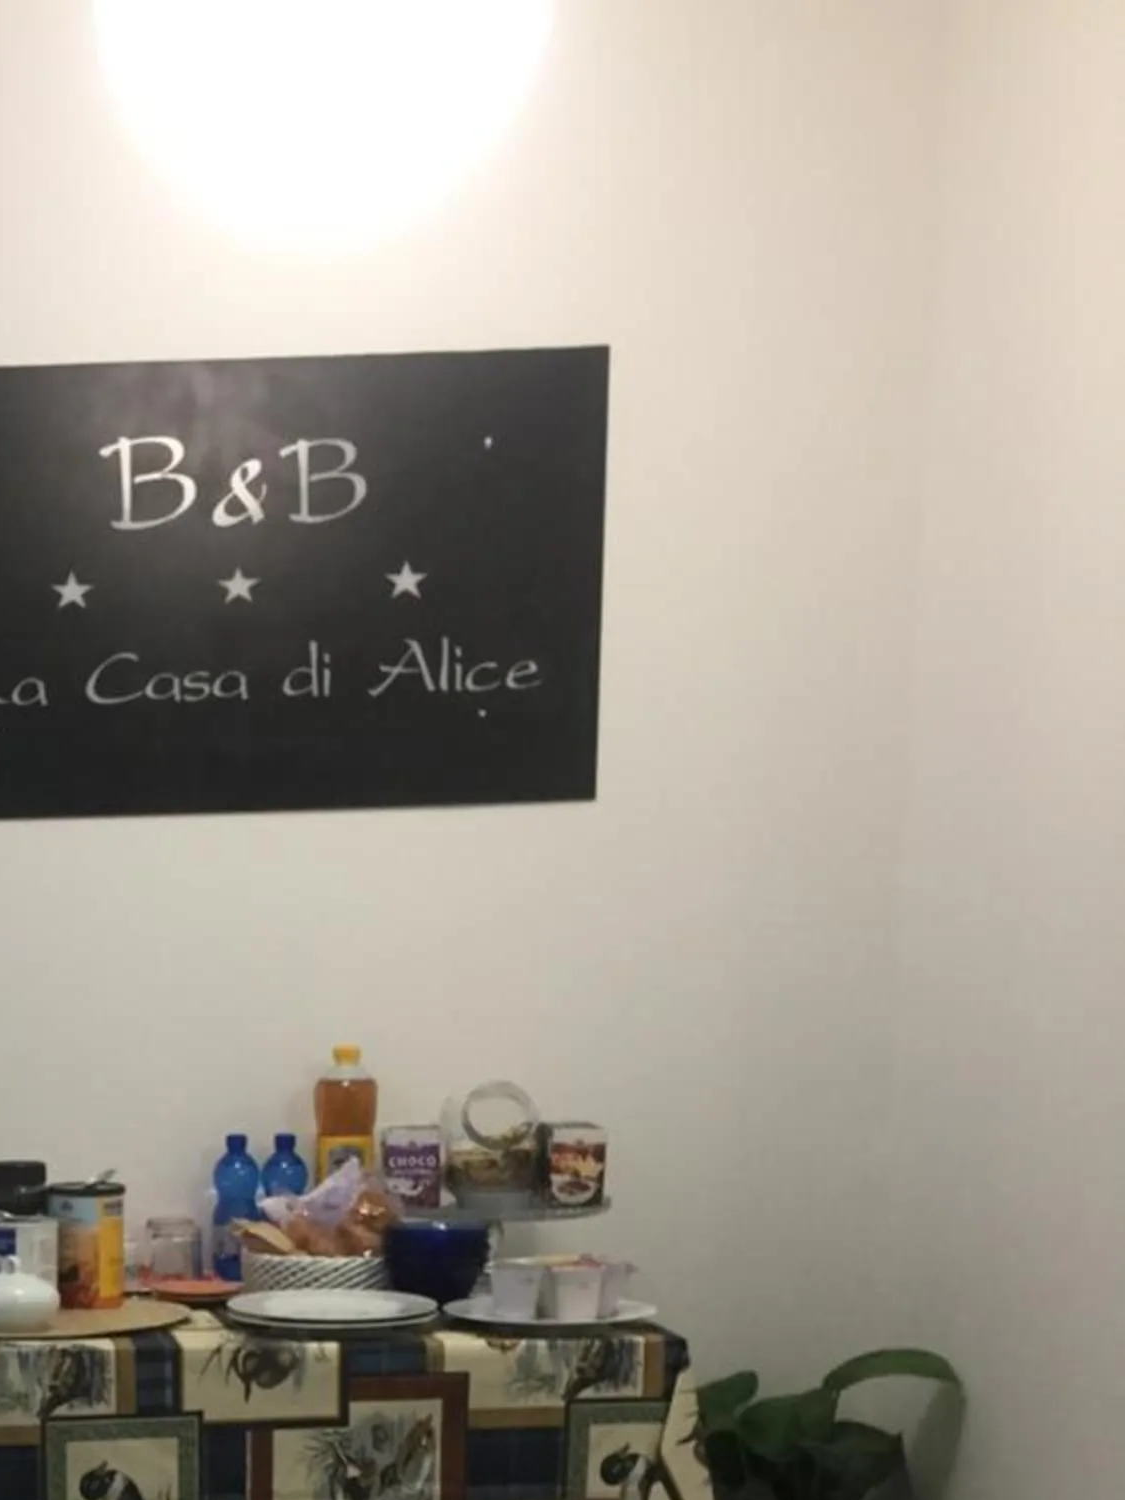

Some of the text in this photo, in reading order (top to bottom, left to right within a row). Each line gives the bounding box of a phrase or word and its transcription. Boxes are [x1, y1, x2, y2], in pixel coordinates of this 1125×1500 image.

[84, 651, 250, 706] Casa
[281, 638, 333, 699] di
[367, 635, 543, 699] Alice
